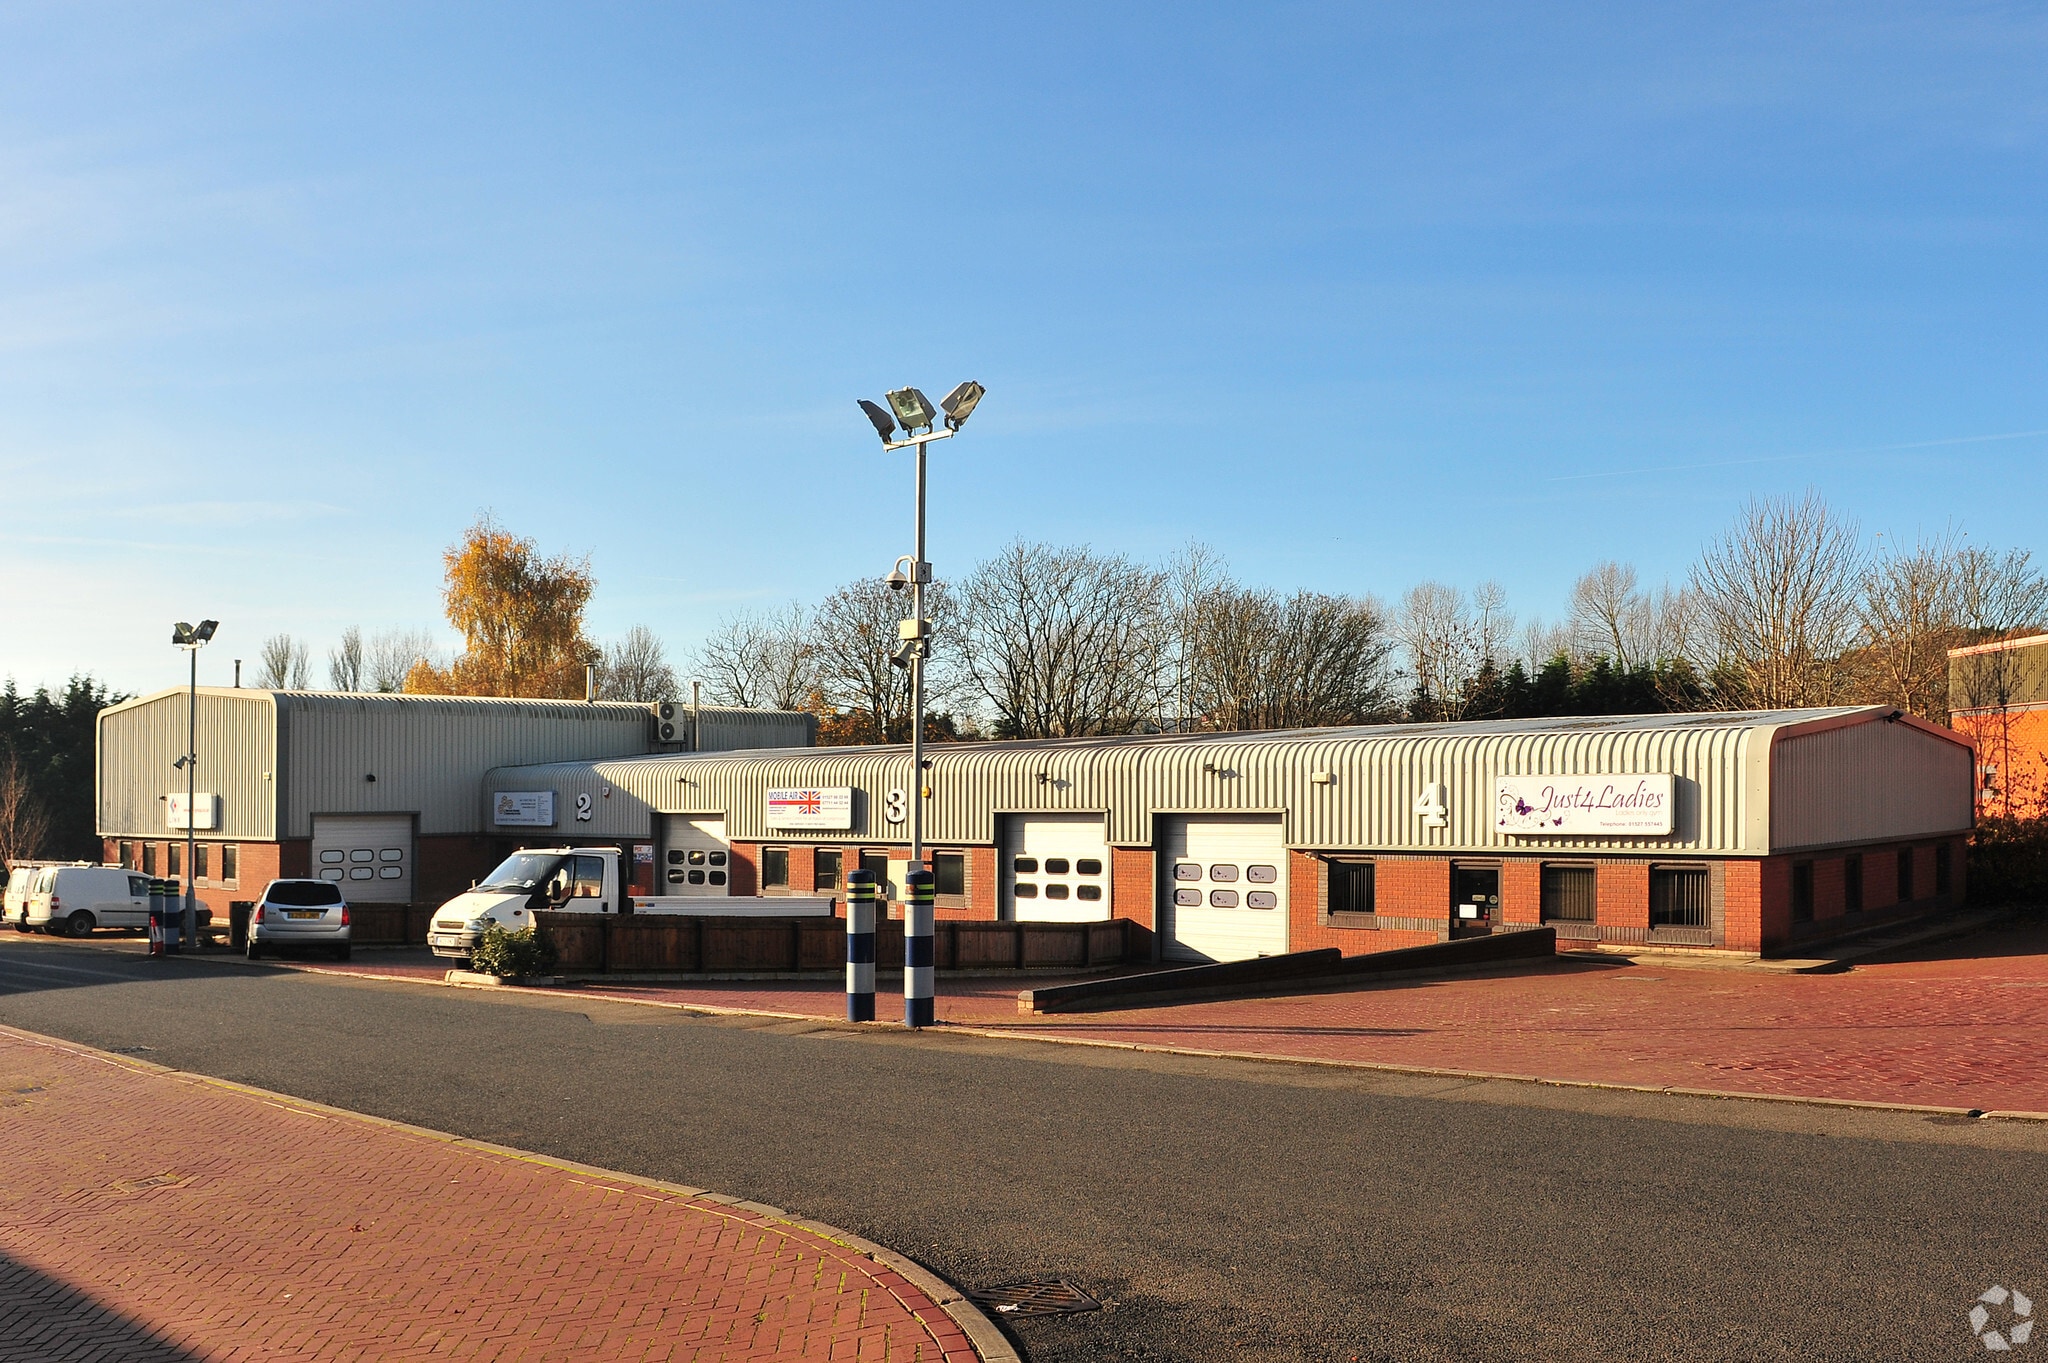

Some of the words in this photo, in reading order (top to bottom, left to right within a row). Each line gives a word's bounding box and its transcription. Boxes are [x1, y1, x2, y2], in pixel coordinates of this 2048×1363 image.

[577, 793, 592, 821] 2
[769, 791, 788, 800] MOBILE
[789, 791, 798, 800] AIR
[886, 788, 907, 824] 3
[1414, 782, 1448, 827] 4
